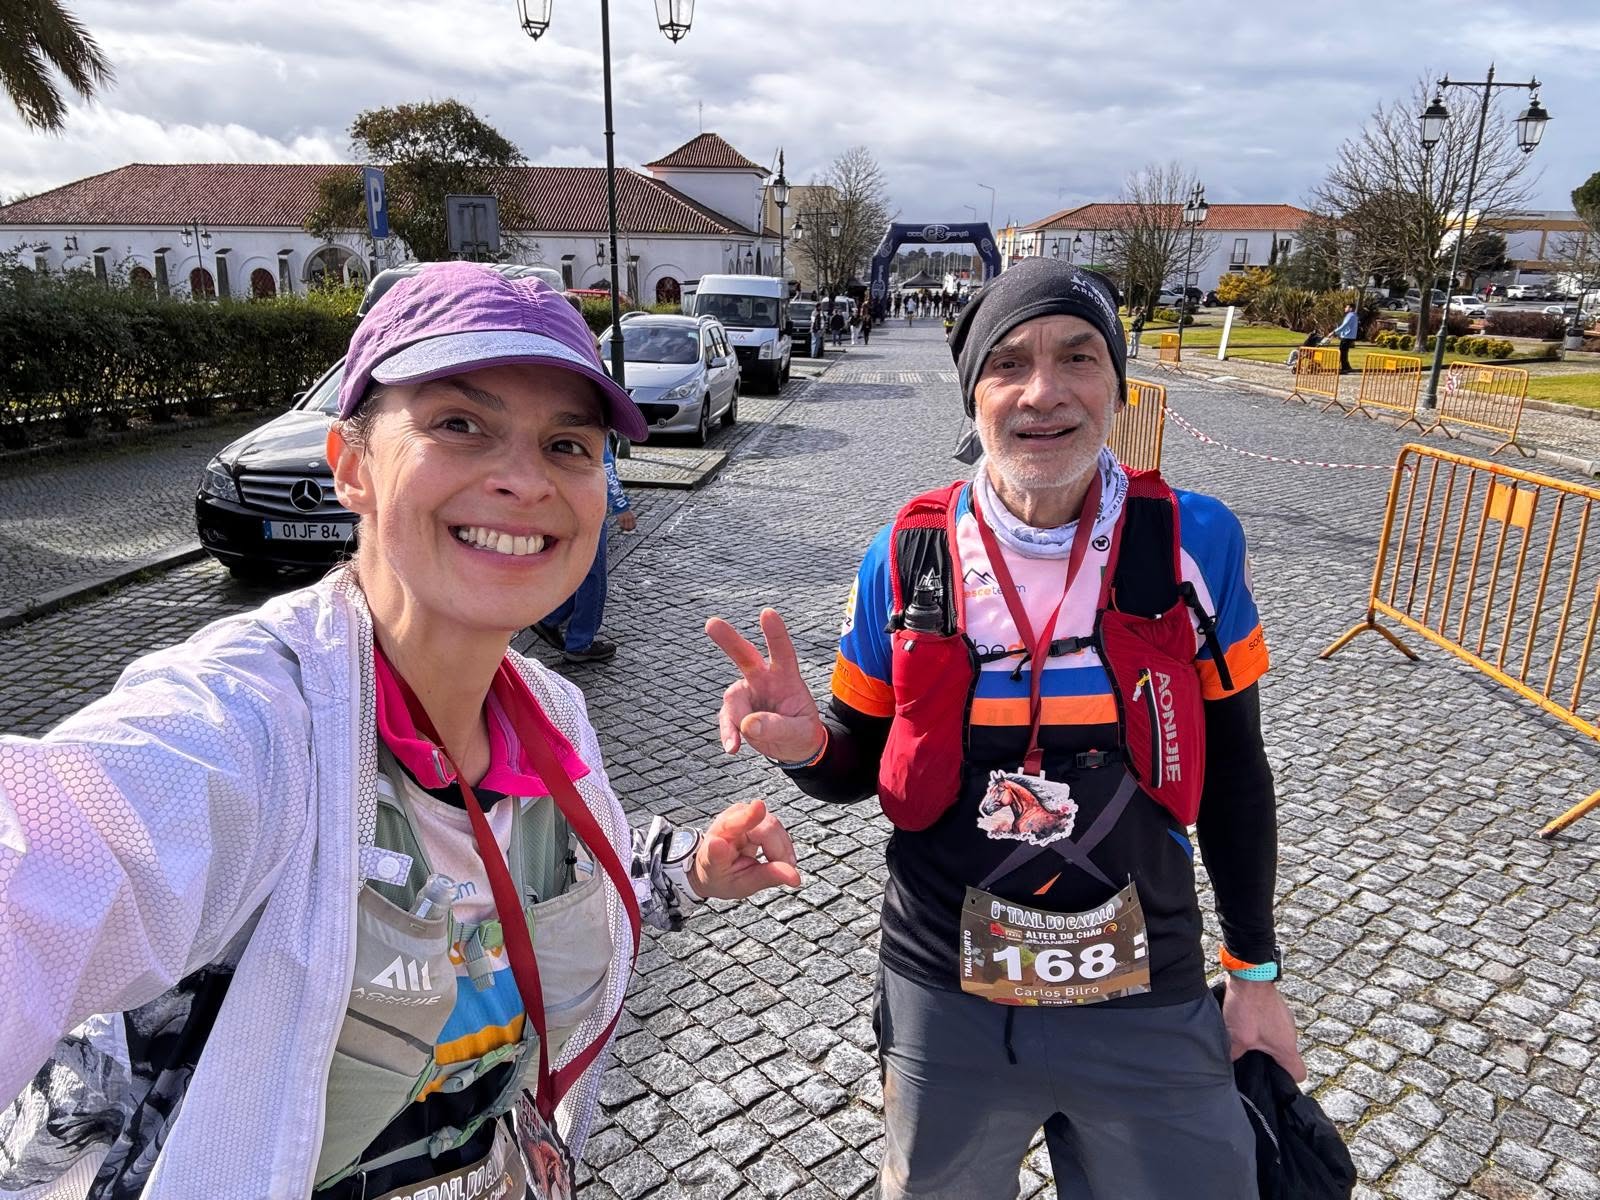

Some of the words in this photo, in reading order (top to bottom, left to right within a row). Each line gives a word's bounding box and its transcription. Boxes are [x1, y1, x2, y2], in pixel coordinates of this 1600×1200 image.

[370, 176, 383, 230] P
[283, 523, 297, 538] 01
[299, 524, 318, 539] JF
[321, 525, 340, 539] 84
[1155, 671, 1182, 782] AONIJIE
[1046, 915, 1065, 930] DO
[1066, 903, 1115, 930] CAVALO
[963, 930, 972, 956] CURTO
[1025, 930, 1056, 940] ALTER
[1060, 932, 1073, 940] DO
[964, 956, 973, 977] TRAIL
[993, 942, 1117, 983] 168
[1014, 987, 1061, 998] Carlos
[1065, 986, 1099, 997] Bilro
